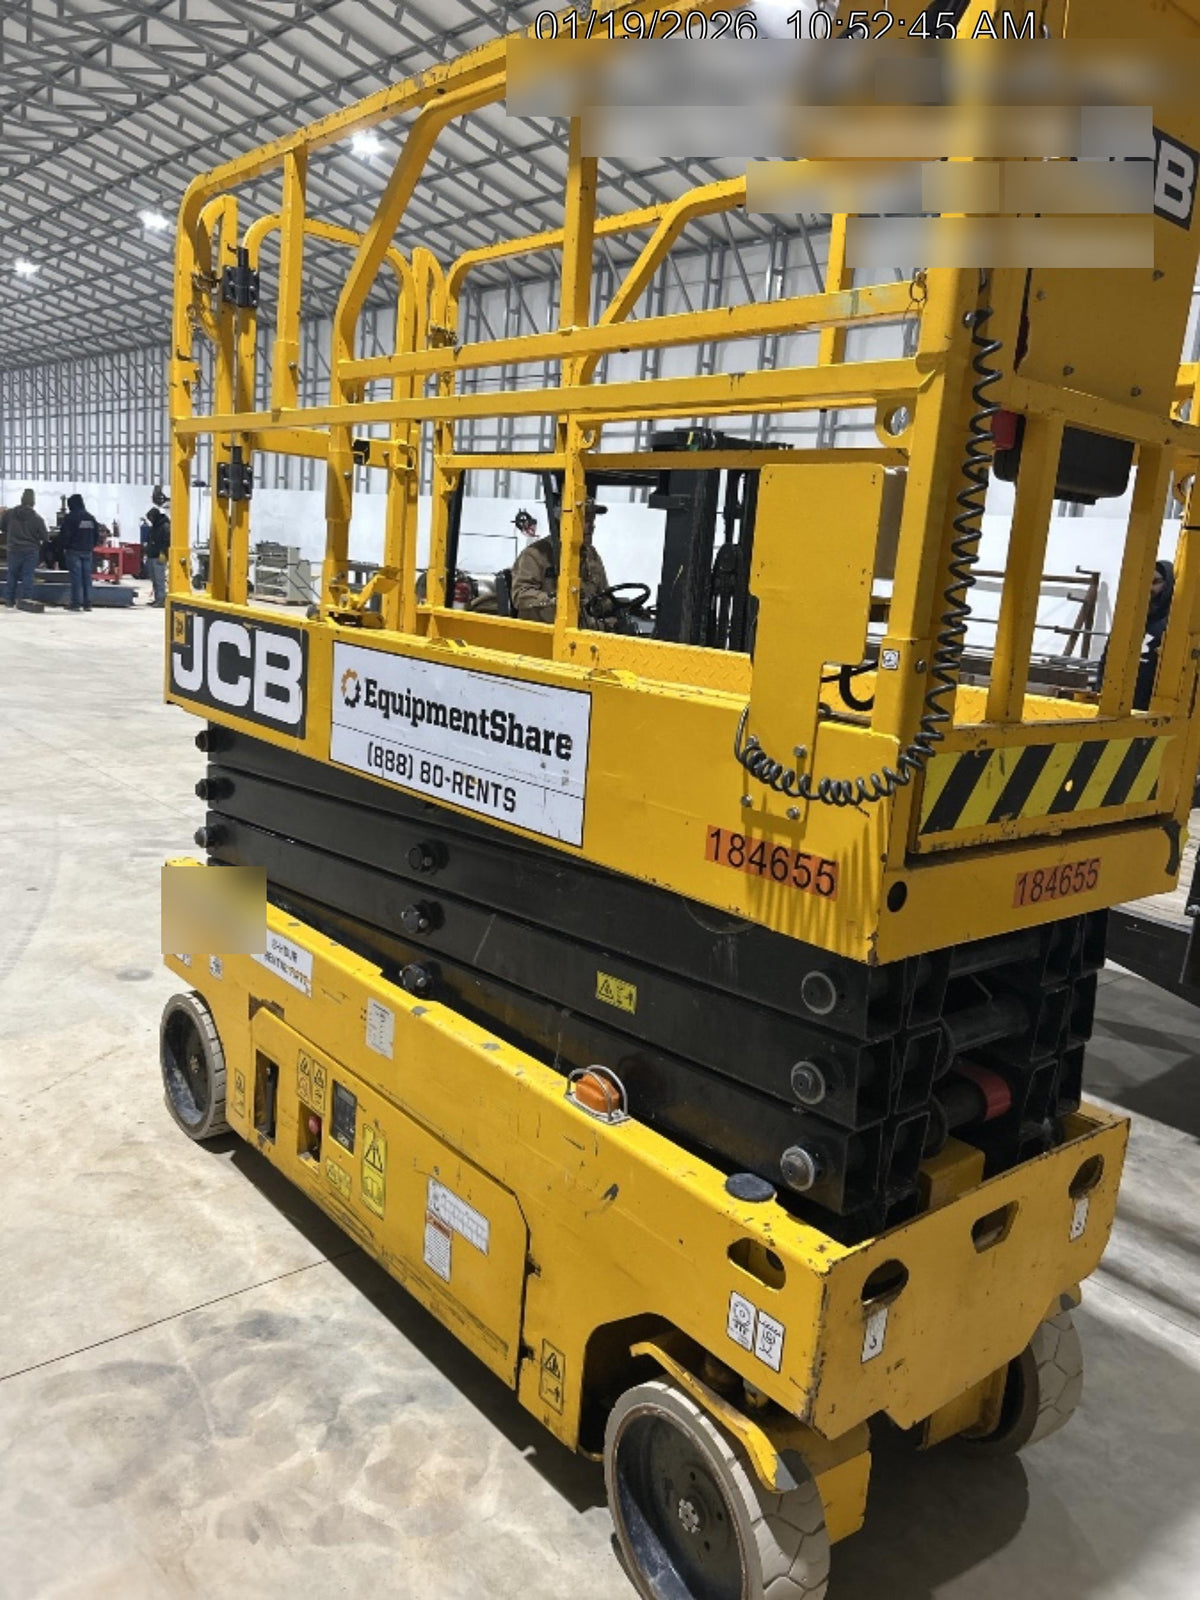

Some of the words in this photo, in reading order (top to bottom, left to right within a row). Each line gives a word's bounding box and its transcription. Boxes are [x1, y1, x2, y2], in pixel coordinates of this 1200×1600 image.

[173, 613, 302, 724] JCB
[364, 677, 573, 762] EquipmentShare
[366, 741, 413, 781] (888)
[420, 760, 517, 813] 80-RENTS
[710, 828, 837, 897] 184655
[1018, 857, 1100, 906] 184655
